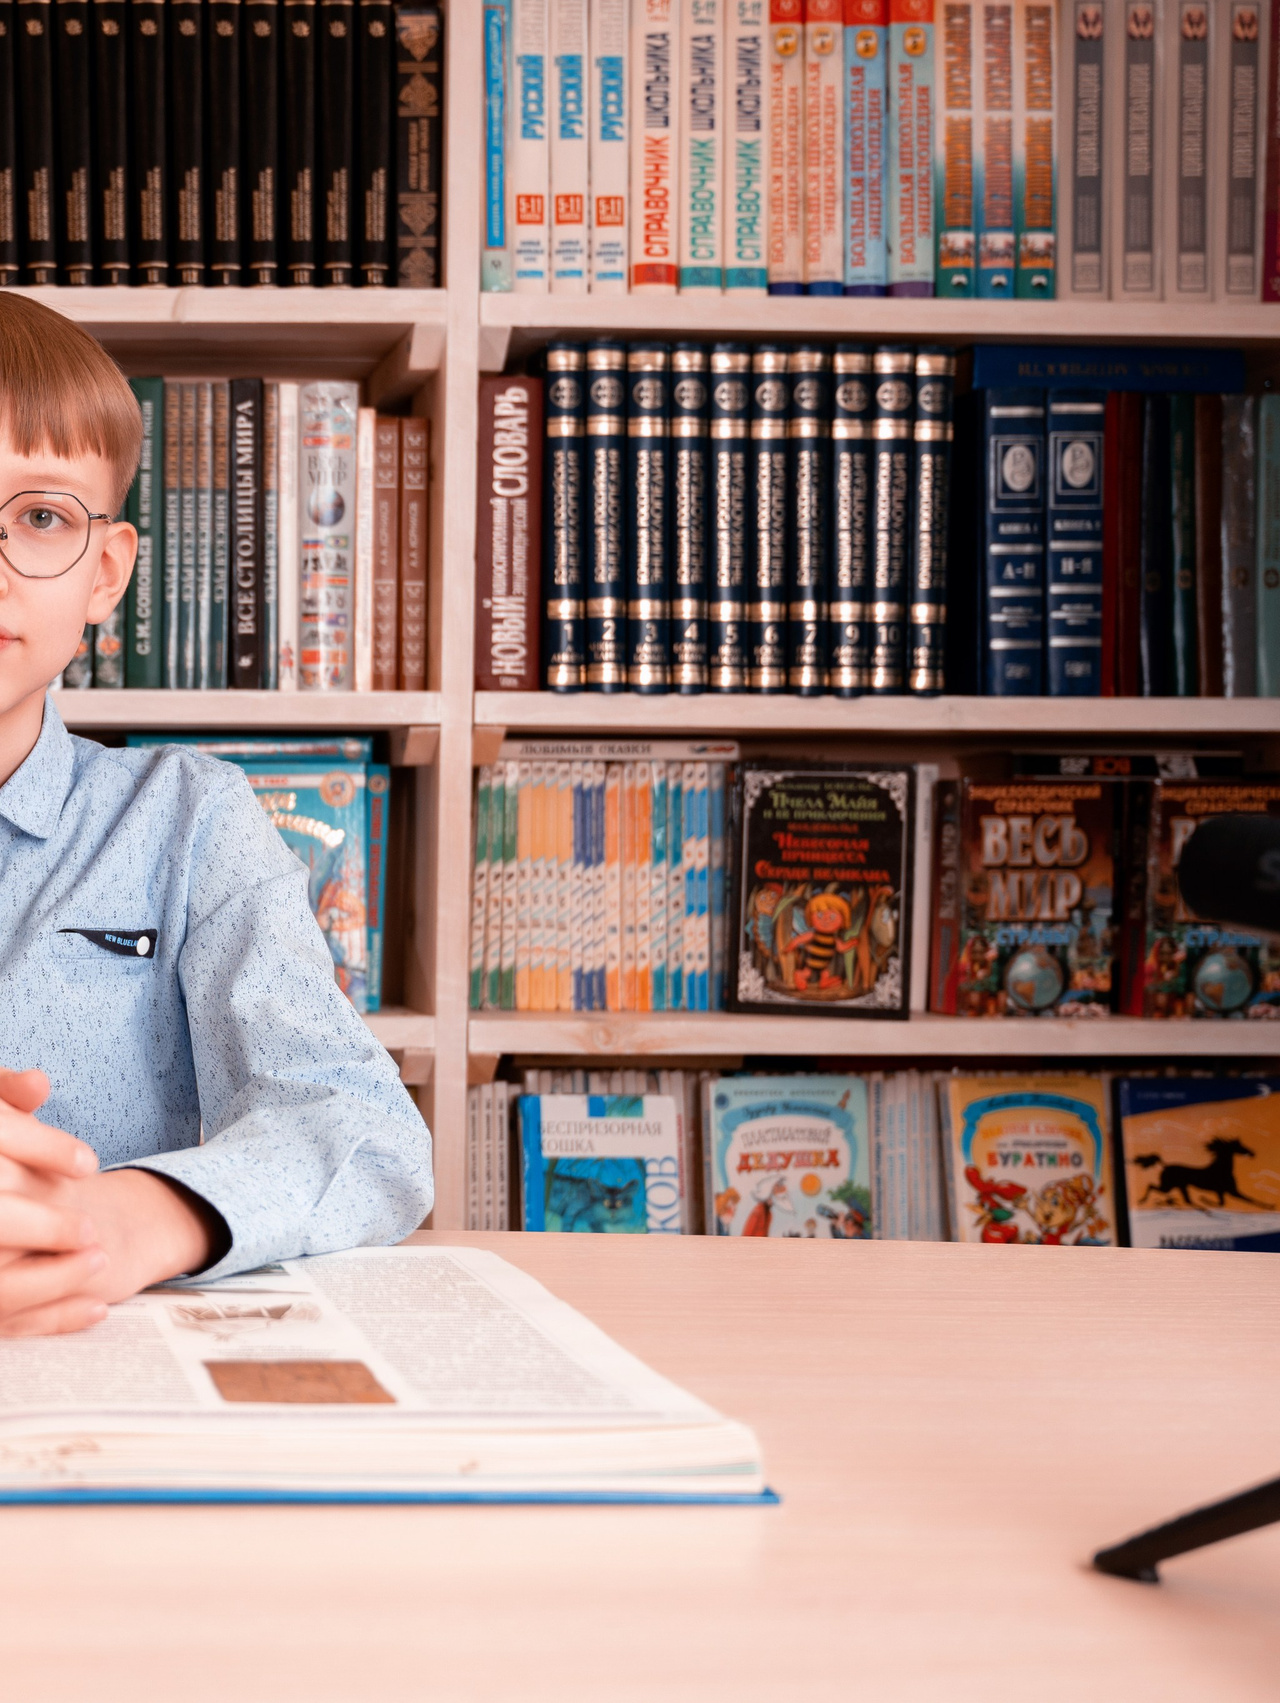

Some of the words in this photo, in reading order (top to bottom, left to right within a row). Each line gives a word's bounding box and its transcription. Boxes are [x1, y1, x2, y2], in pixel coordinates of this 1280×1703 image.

[516, 54, 544, 141] РУССКИЙ
[554, 54, 583, 141] РУССКИЙ
[594, 56, 624, 142] РУССКИЙ
[645, 32, 670, 128] ШКОЛЬНИКА
[690, 35, 715, 131] ШКОЛЬНИКА
[736, 36, 761, 132] ШКОЛЬНИКА
[771, 62, 784, 169] ШКОЛЬНАЯ
[807, 61, 820, 167] ШКОЛЬНАЯ
[898, 62, 914, 169] ШКОЛЬНАЯ
[850, 65, 865, 171] ШКОЛЬНАЯ
[786, 85, 799, 237] ЭНЦИКЛОПЕДИЯ
[823, 84, 836, 236] ЭНЦИКЛОПЕДИЯ
[868, 87, 883, 241] ЭНЦИКЛОПЕДИЯ
[917, 86, 932, 238] ЭНЦИКЛОПЕДИЯ
[643, 135, 670, 258] СПРАВОЧНИК
[689, 137, 715, 259] СПРАВОЧНИК
[736, 139, 761, 260] СПРАВОЧНИК
[771, 174, 784, 265] БОЛЬШАЯ
[807, 173, 820, 264] БОЛЬШАЯ
[850, 176, 866, 268] БОЛЬШАЯ
[900, 174, 916, 265] БОЛЬШАЯ
[235, 400, 255, 468] МИРА
[493, 386, 529, 497] СЛОВАРЬ
[166, 493, 178, 564] КИЕВСКАЯ
[182, 493, 194, 564] КИЕВСКАЯ
[198, 493, 209, 565] КИЕВСКАЯ
[214, 493, 226, 565] КИЕВСКАЯ
[236, 469, 258, 588] СТОЛИЦЫ
[265, 495, 277, 566] КИЕВСКАЯ
[137, 535, 152, 618] СОЛОВЬЕВ
[164, 567, 178, 602] РУСЬ
[181, 567, 194, 602] РУСЬ
[196, 567, 209, 602] РУСЬ
[213, 568, 226, 603] РУСЬ
[237, 588, 256, 635] ВСЕ
[263, 568, 276, 603] РУСЬ
[482, 595, 527, 675] НОВЫЙ
[564, 623, 573, 641] 1
[603, 621, 616, 640] 2
[645, 623, 657, 642] 3
[684, 622, 697, 641] 4
[725, 624, 737, 644] 5
[766, 624, 778, 644] 6
[805, 624, 816, 644] 7
[846, 624, 859, 644] 9
[878, 624, 900, 644] 10
[519, 742, 593, 755] ЛЮБИМЫЕ
[599, 740, 652, 754] СКАЗКИ
[980, 815, 1089, 868] ВЕСЬ
[994, 800, 1075, 814] СПРАВОЧНИК
[984, 868, 1081, 921] МИР
[105, 933, 116, 943] NEW
[736, 1148, 842, 1175] ДЕДУШКА
[986, 1151, 1084, 1169] БУРАТИНО
